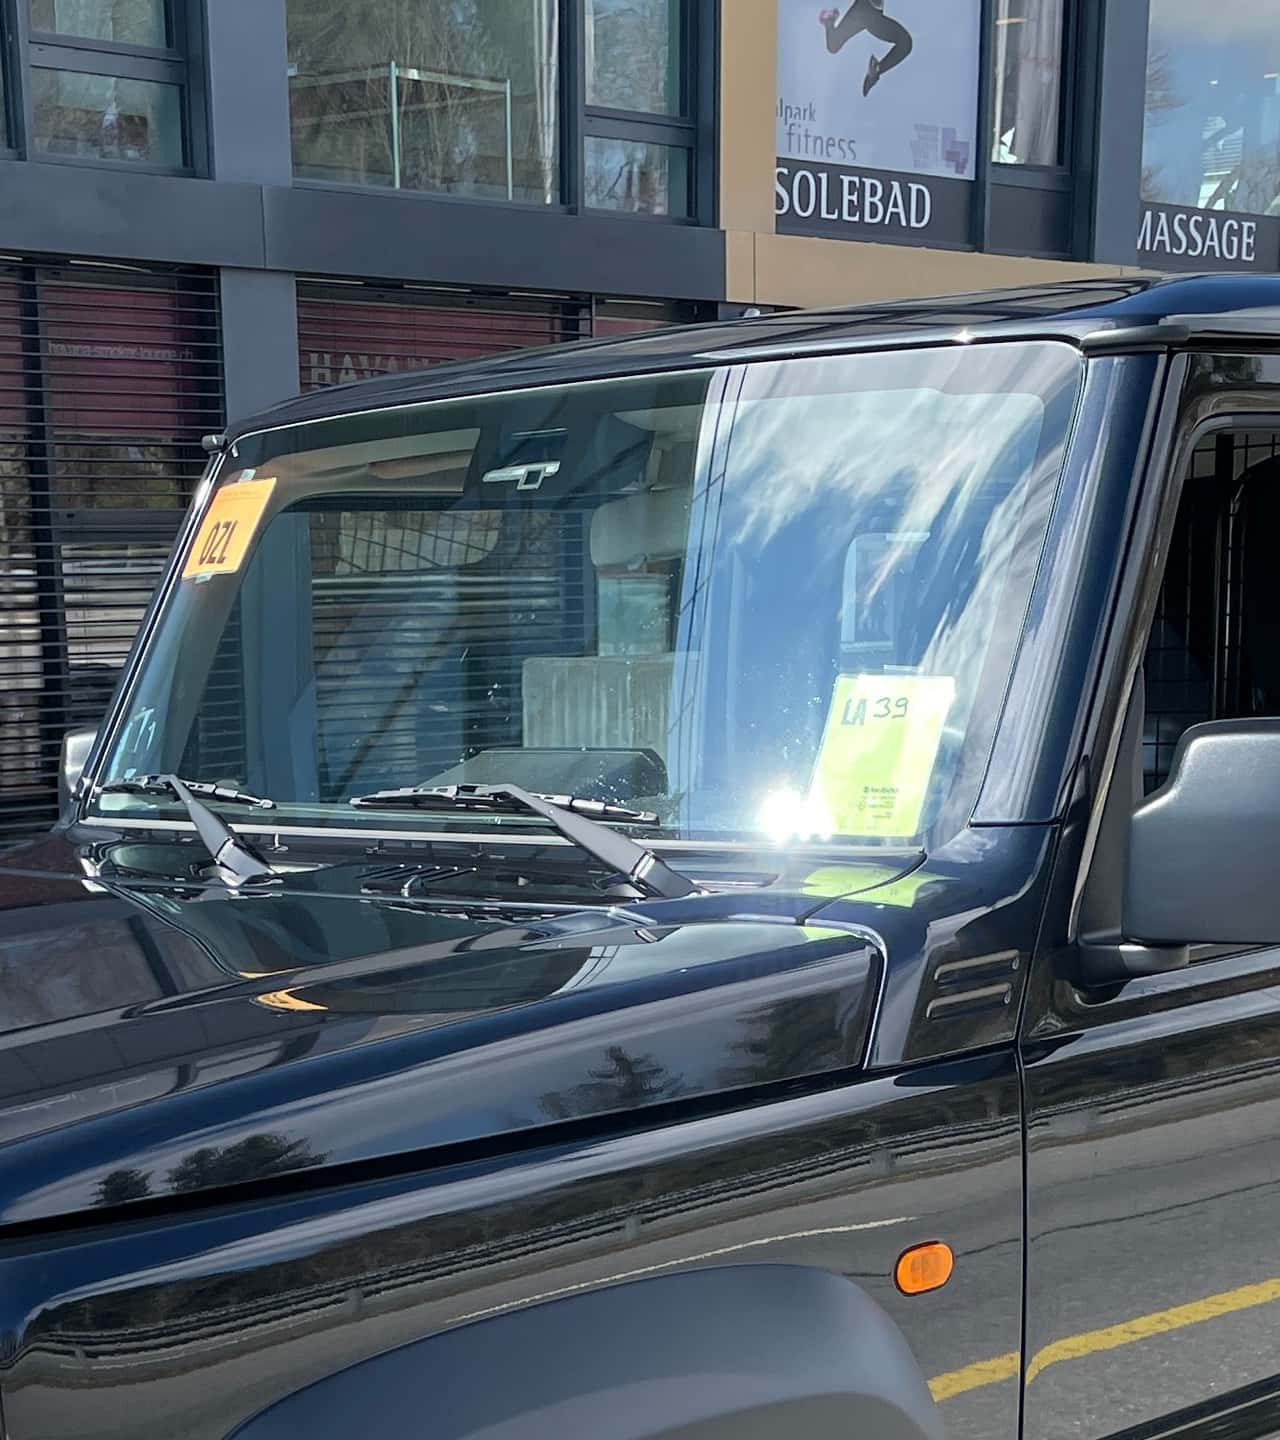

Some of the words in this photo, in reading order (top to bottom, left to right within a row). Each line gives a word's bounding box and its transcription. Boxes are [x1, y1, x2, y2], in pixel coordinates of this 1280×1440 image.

[776, 96, 817, 125] lpark
[786, 122, 857, 160] fitness
[775, 167, 932, 229] SOLEBAD
[873, 696, 910, 719] 39
